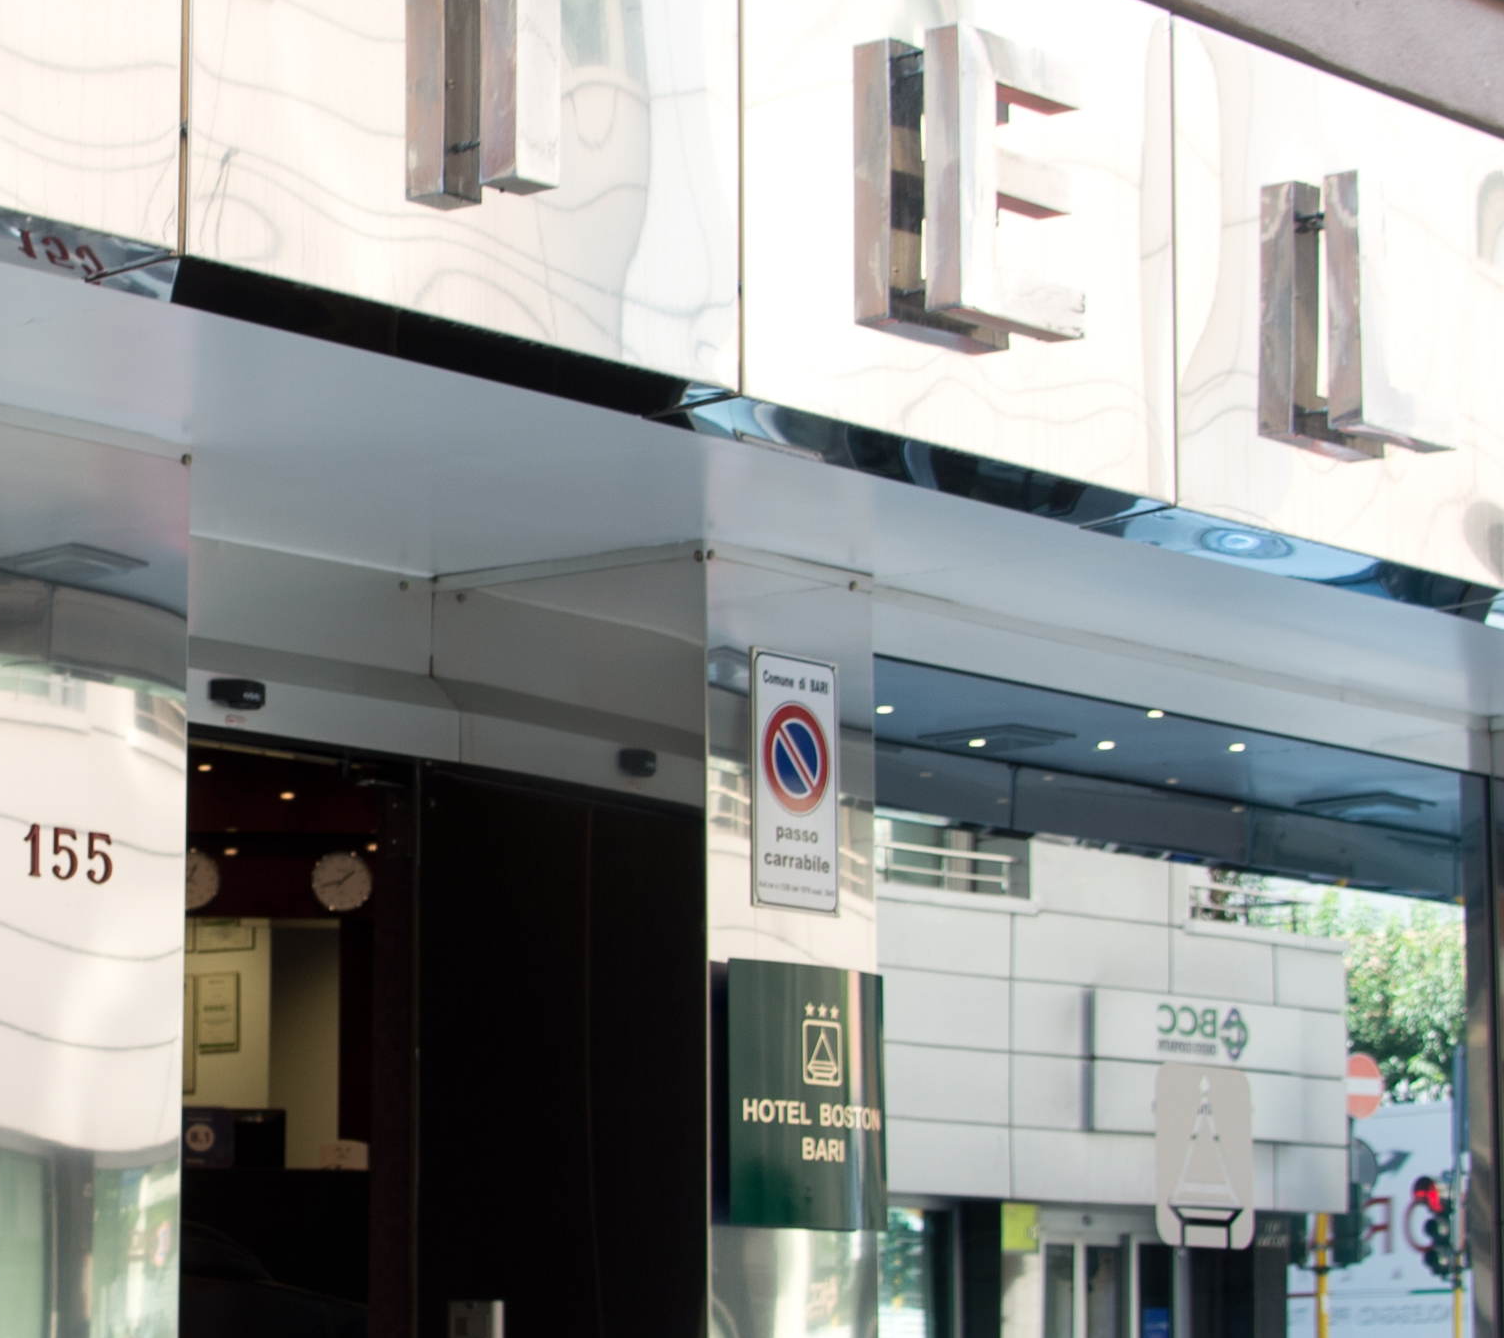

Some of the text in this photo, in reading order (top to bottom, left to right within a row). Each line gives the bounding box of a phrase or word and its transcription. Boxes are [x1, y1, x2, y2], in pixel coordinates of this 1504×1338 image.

[763, 670, 829, 695] Comune di BARI
[776, 824, 819, 844] passo
[23, 823, 114, 885] 155
[764, 851, 830, 874] carrabile
[742, 1098, 882, 1131] HOTEL BOSTON
[802, 1136, 845, 1163] BARI
